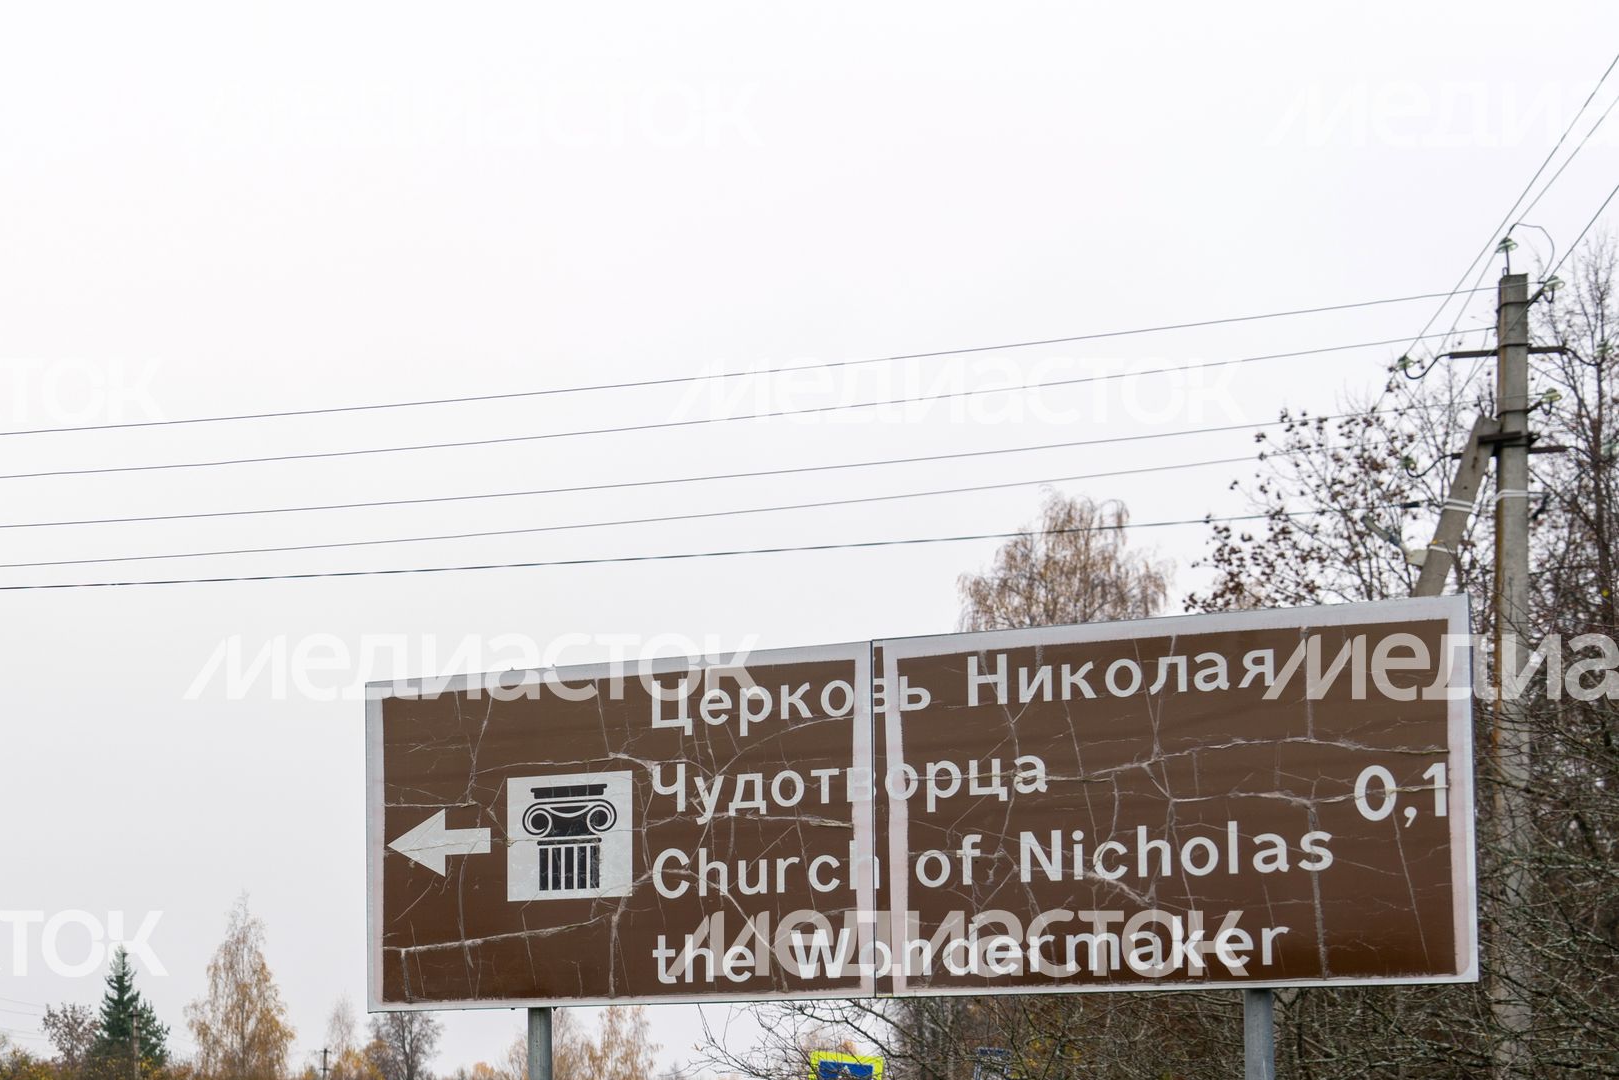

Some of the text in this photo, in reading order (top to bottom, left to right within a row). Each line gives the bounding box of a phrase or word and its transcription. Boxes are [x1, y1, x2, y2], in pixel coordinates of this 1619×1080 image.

[651, 649, 1274, 736] Церковь Николая
[653, 754, 1048, 825] Чудотворца
[1354, 762, 1447, 828] 0,1
[652, 820, 1334, 899] Church of Nicholas
[652, 914, 1290, 984] the Wondermaker
